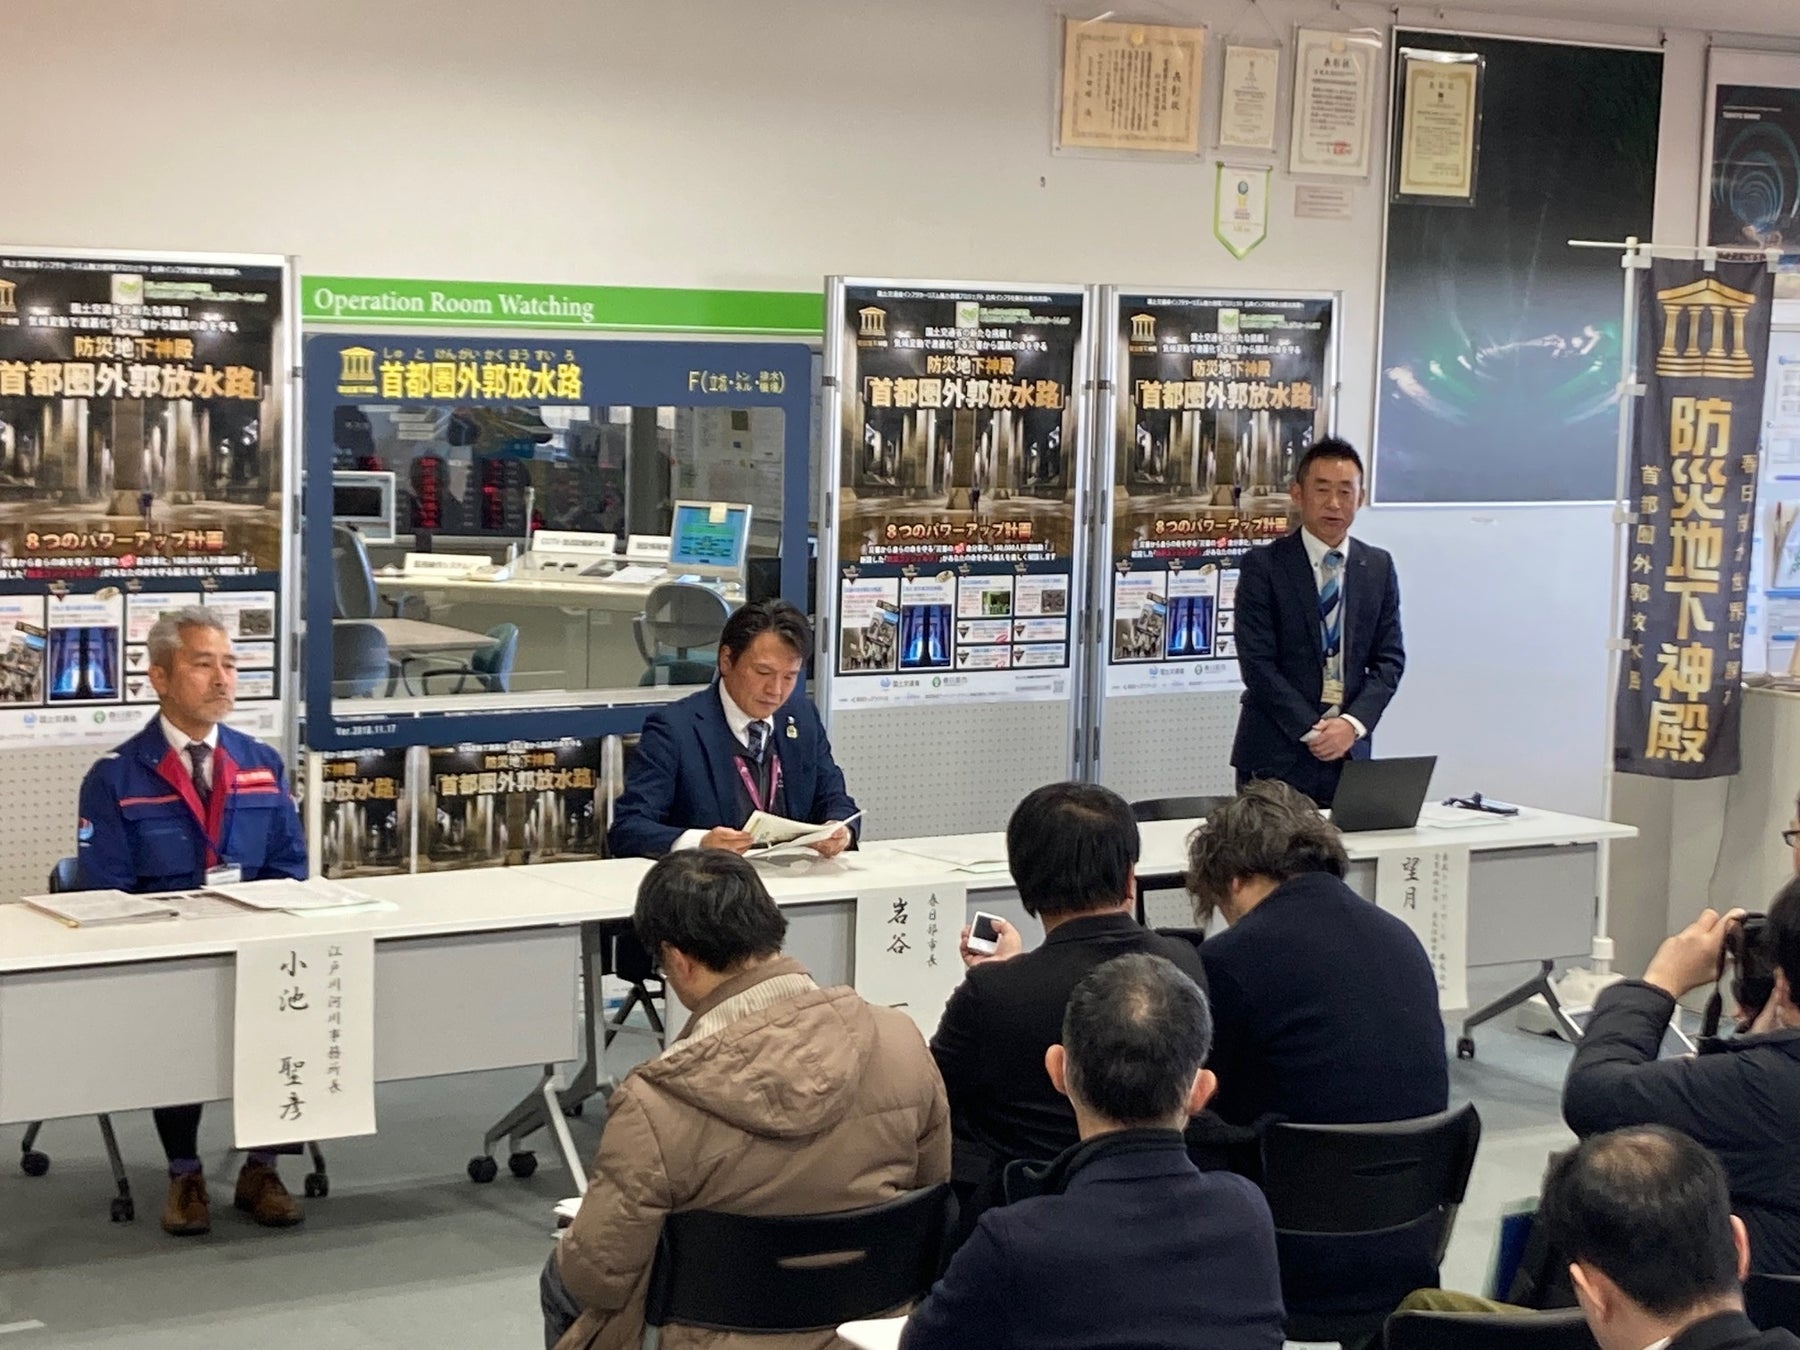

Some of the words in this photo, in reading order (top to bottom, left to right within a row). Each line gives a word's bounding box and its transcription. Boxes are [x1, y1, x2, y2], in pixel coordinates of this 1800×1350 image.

[314, 288, 424, 316] Operation
[430, 292, 493, 314] Room
[498, 294, 594, 323] Watching
[74, 336, 194, 359] 防災地下神殿
[379, 361, 582, 400] 首都圏外郭放水路
[927, 356, 1015, 376] 防災地下神殿
[1192, 360, 1271, 377] 防災地下神殿
[864, 376, 1065, 410] 「首都圏外郭放水路」
[1136, 379, 1316, 410] 「首都圏外郭放水路」
[25, 530, 225, 550] 8つのパワーアップ計画
[886, 522, 1033, 540] 8つのパワーアップ計画
[1155, 517, 1289, 534] 8つのパワーアップ計画
[1645, 396, 1732, 763] 防災地下神殿
[1402, 857, 1420, 910] 望月
[887, 897, 911, 954] 岩谷
[927, 893, 939, 967] 春日部市長
[279, 951, 309, 1012] 小池
[327, 945, 343, 1094] 江戸川河川事務所長
[278, 1056, 306, 1121] 聖彦
